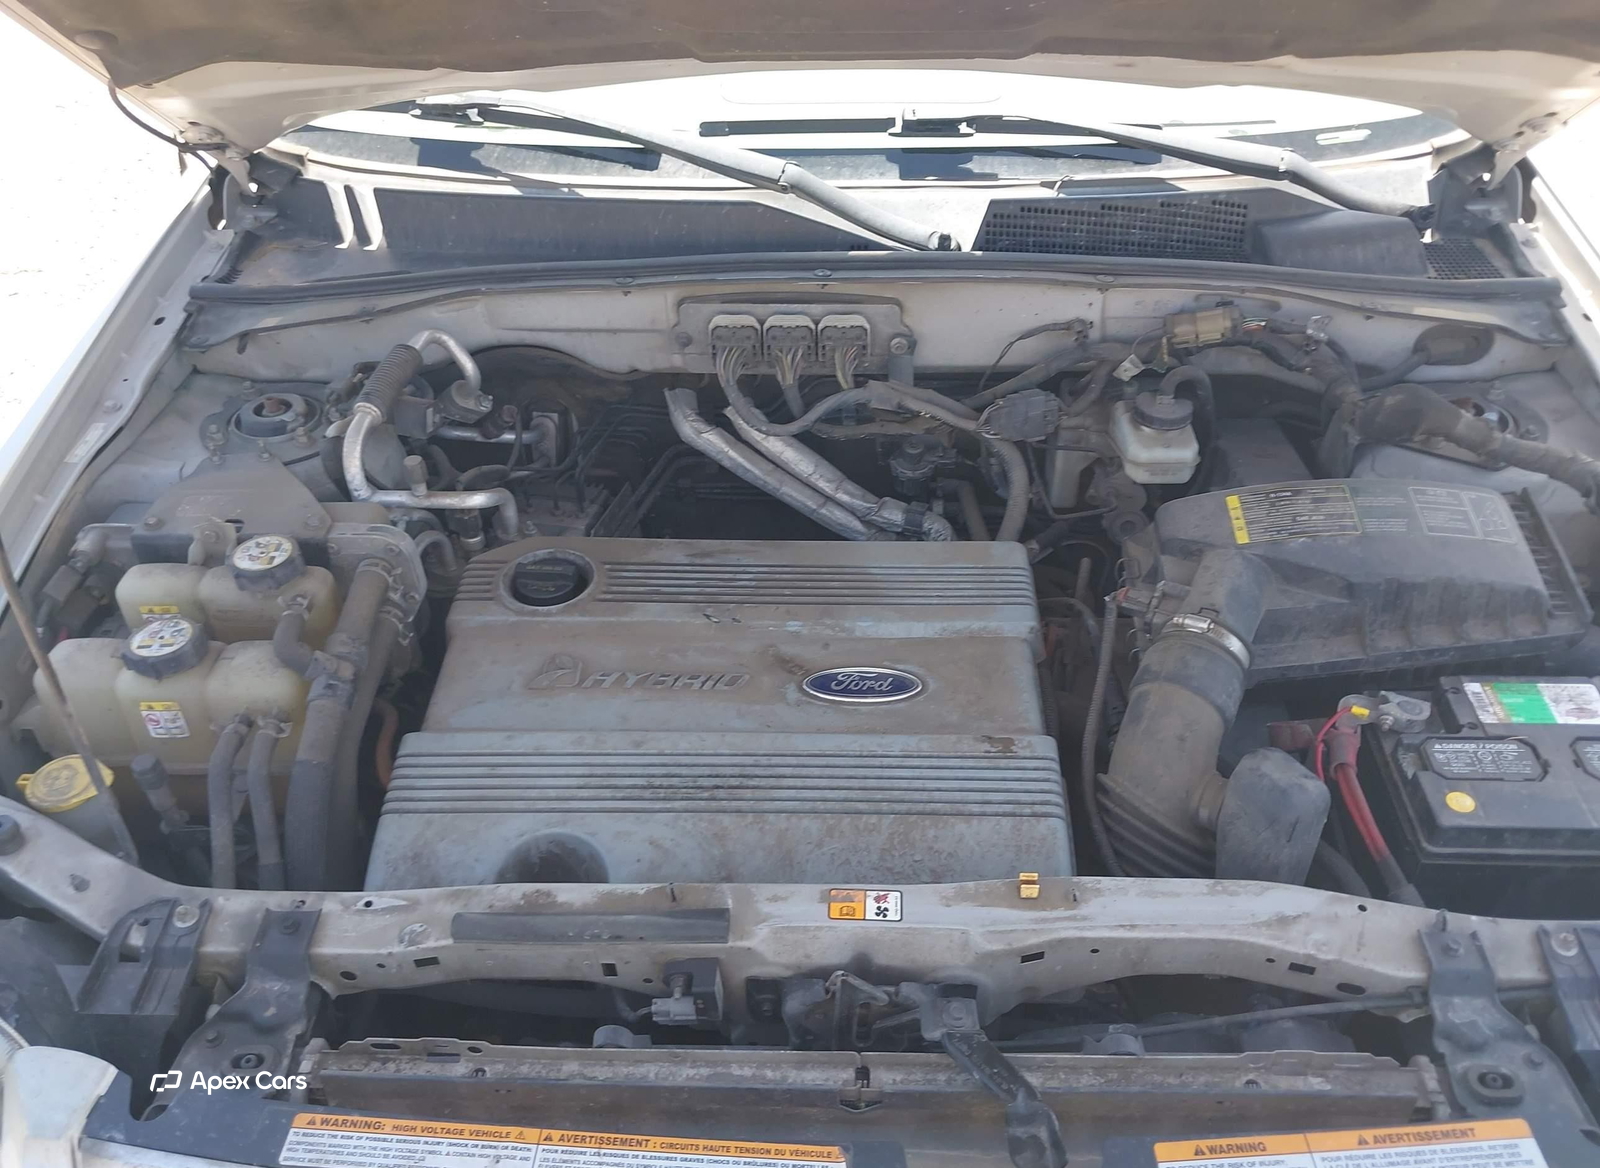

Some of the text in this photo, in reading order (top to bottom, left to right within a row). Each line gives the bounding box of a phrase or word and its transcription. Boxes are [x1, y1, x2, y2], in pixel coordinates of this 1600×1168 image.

[582, 671, 751, 690] HYBRID
[830, 672, 894, 692] Ford
[301, 1131, 325, 1139] REDUCE
[320, 1117, 512, 1139] WARNING: HIGH VOLTAGE VEHICLE
[1372, 1128, 1476, 1145] AVERTISSEMENT
[327, 1142, 352, 1150] MARKED
[353, 1143, 367, 1151] WITH
[394, 1147, 419, 1155] VOLTAGE
[557, 1133, 651, 1148] AVERTISSEMENT
[659, 1141, 700, 1151] CIRCUITS
[702, 1144, 731, 1153] HAUTE
[734, 1146, 772, 1156] TENSION
[773, 1148, 786, 1156] DU
[788, 1147, 833, 1159] VÉHICULE
[1205, 1141, 1267, 1155] WARNING
[602, 1151, 631, 1159] RISQUES
[641, 1154, 677, 1162] BLESSURES
[679, 1156, 704, 1164] GRAVES
[706, 1158, 731, 1166] (CHOCS
[1320, 1155, 1342, 1163] POUR
[1379, 1152, 1393, 1160] LES
[1394, 1150, 1427, 1158] RISQUES
